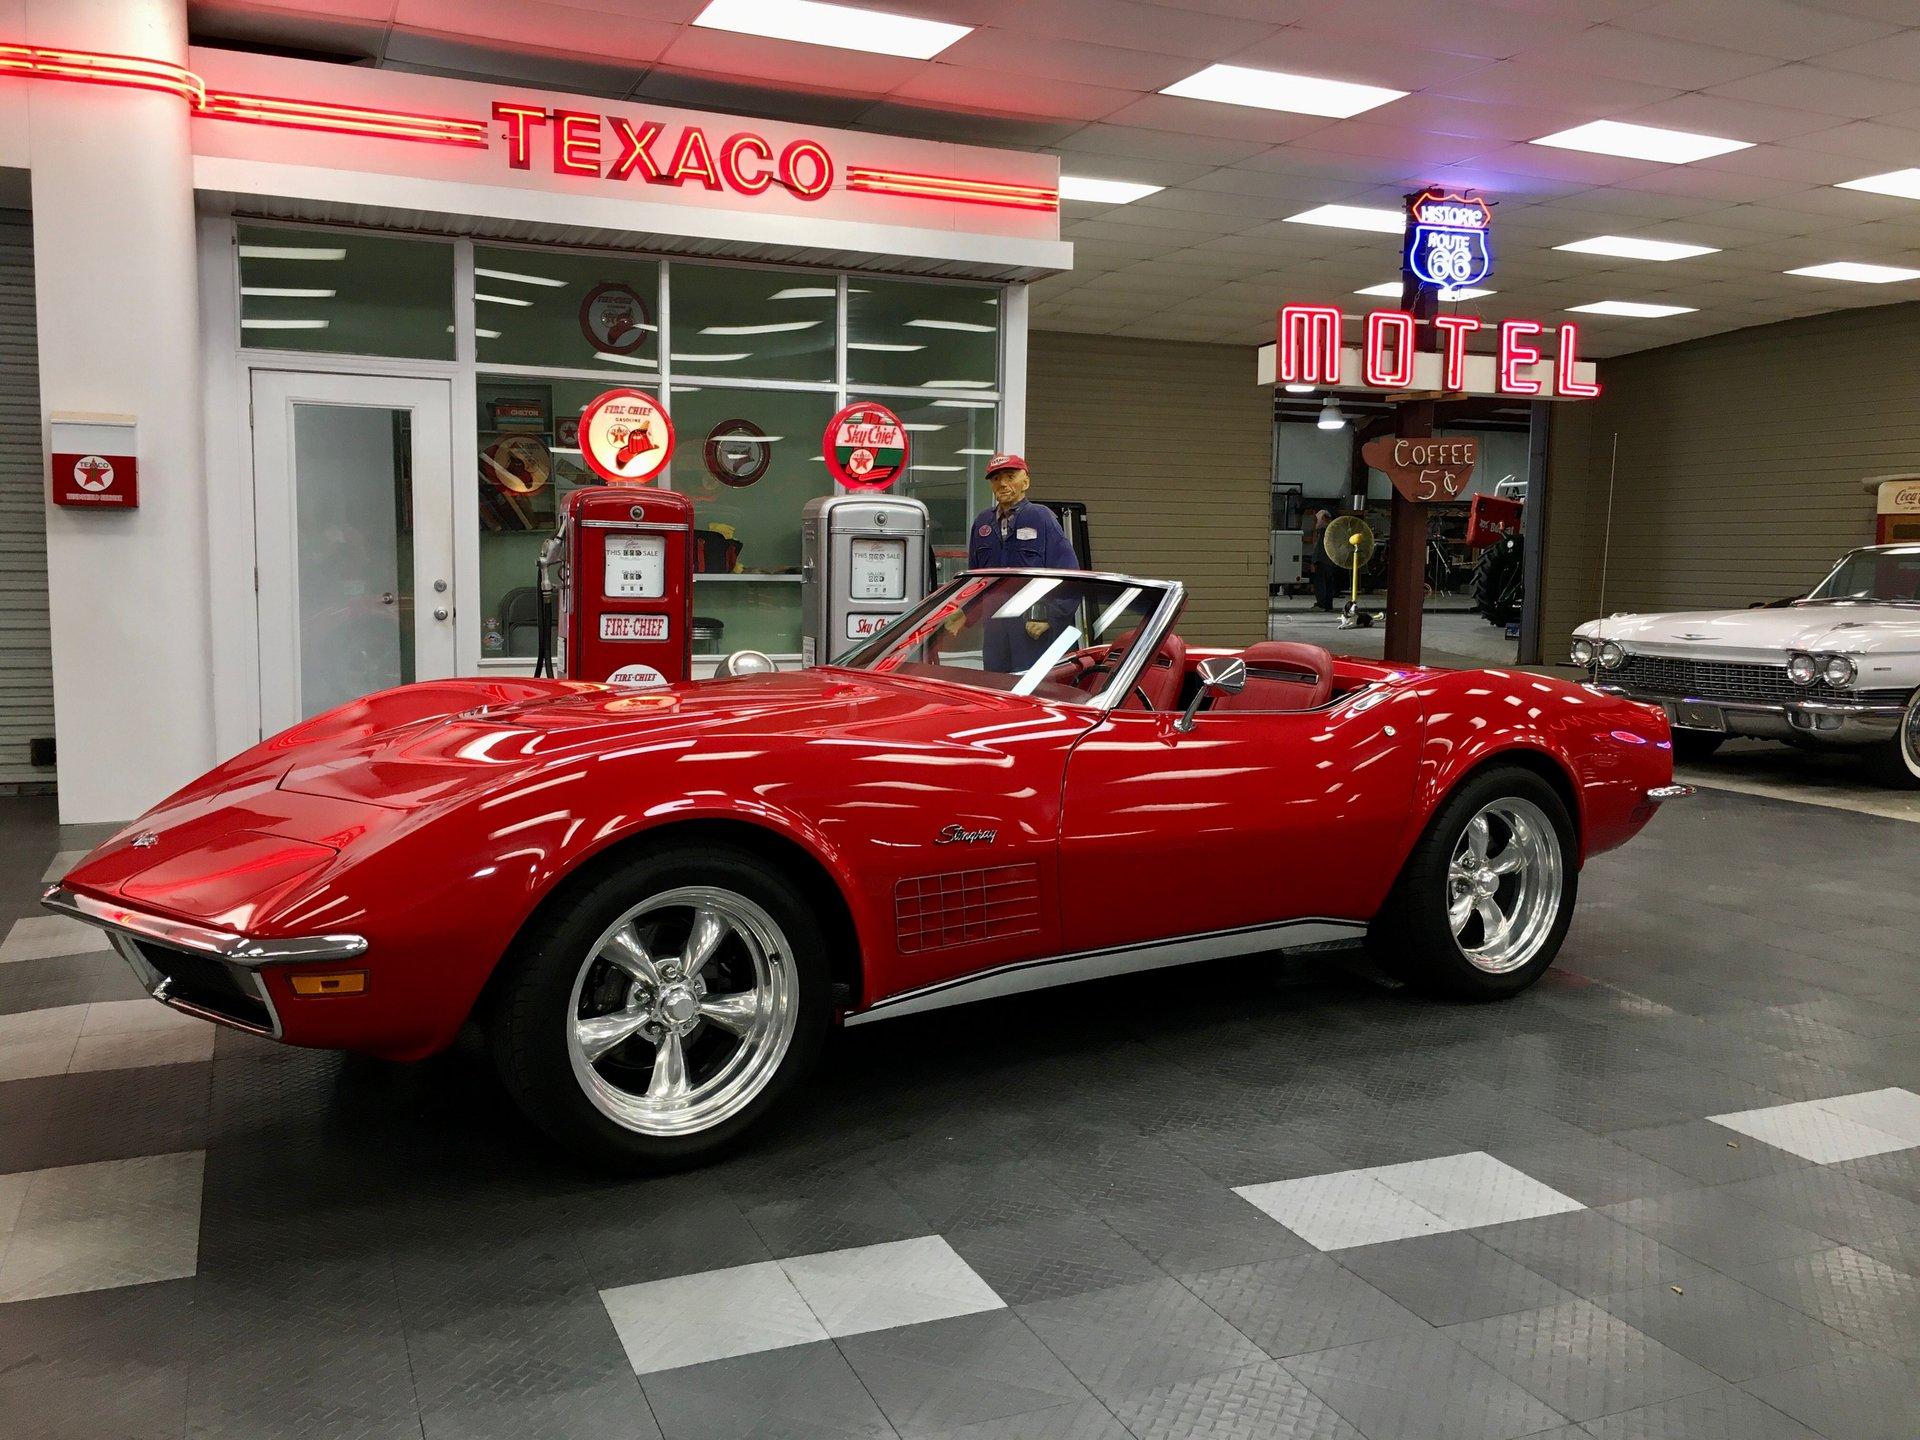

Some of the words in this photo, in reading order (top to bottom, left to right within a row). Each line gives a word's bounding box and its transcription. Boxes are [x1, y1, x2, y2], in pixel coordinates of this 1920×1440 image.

[492, 101, 834, 201] TEXACO
[1420, 205, 1483, 228] HISTORIC
[1427, 232, 1470, 250] ROUTE
[1427, 247, 1472, 281] 66
[1276, 302, 1602, 398] MOTEL
[510, 407, 539, 416] CHILTON
[604, 405, 653, 416] FIRE-CHIEF
[844, 425, 867, 447] Sky
[868, 425, 897, 445] Chief
[1394, 440, 1475, 467] COFFEE
[80, 461, 109, 469] TEXACO
[1895, 488, 1920, 505] Coca
[605, 618, 664, 637] FIRE-CHIEF
[856, 618, 872, 634] Sky
[614, 673, 657, 682] FIRE-CHIEF
[935, 823, 998, 844] Stingray
